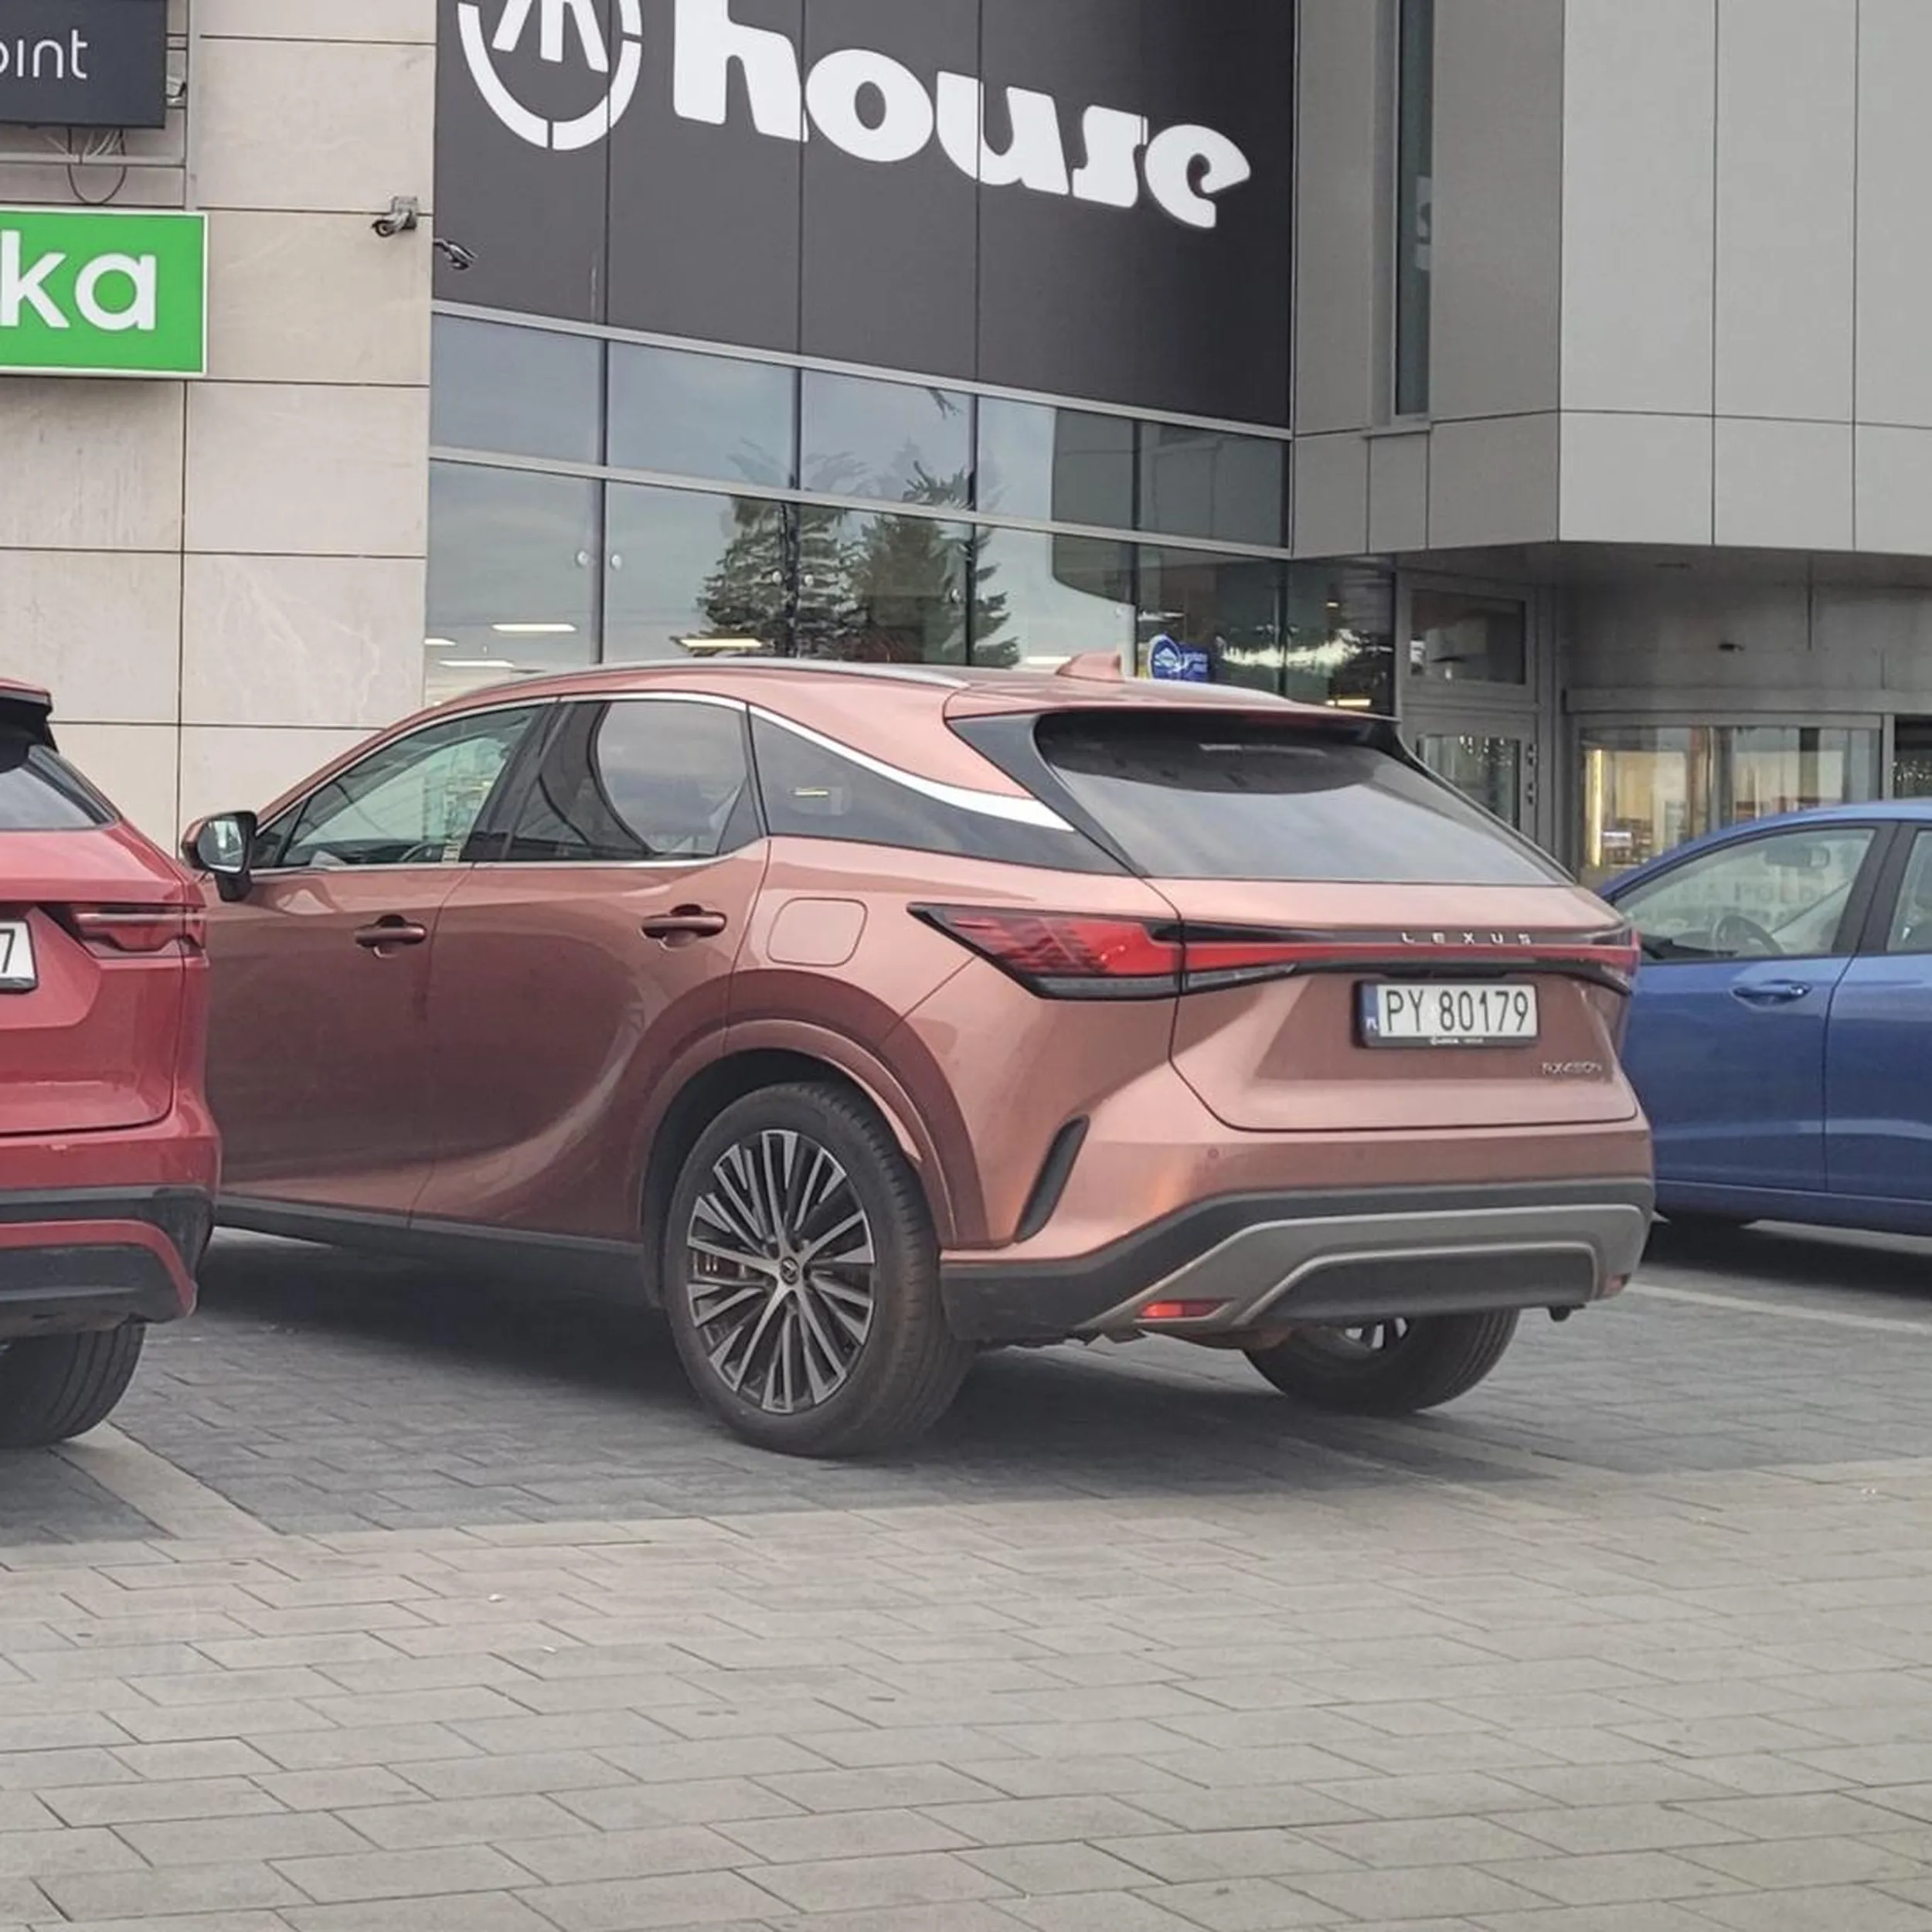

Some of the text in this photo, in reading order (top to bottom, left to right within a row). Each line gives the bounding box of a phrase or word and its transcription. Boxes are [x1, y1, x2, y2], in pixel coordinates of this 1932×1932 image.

[673, 0, 1251, 229] house
[0, 230, 157, 331] ka
[0, 928, 15, 973] 7
[1401, 931, 1532, 945] LEXUS
[1386, 988, 1529, 1032] PY 80179
